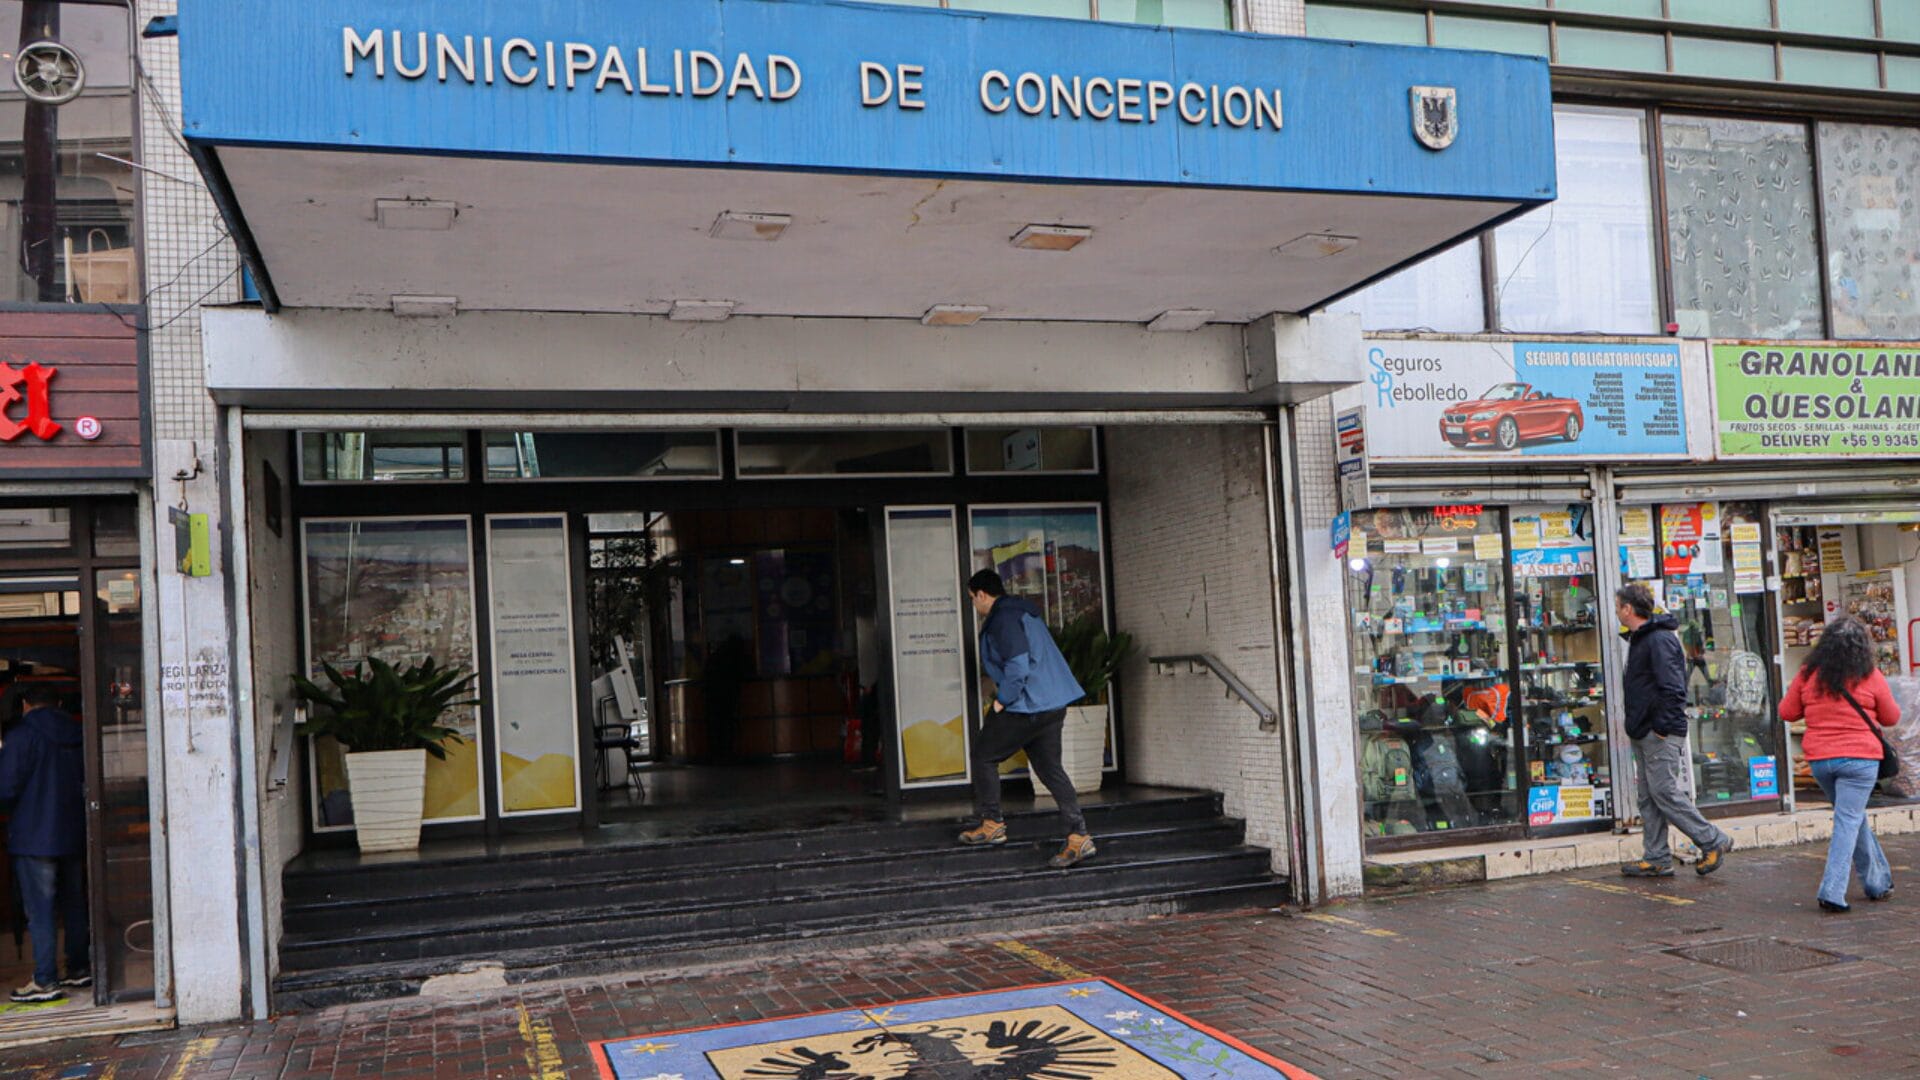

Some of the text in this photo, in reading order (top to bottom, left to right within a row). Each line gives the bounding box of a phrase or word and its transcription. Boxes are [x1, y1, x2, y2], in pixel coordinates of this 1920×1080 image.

[343, 27, 1283, 130] MUNICIPALIDAD DE CONCEPCION
[1369, 348, 1442, 383] Seguros
[1525, 351, 1569, 366] SEGURO
[1377, 371, 1468, 408] Rebolledo
[1850, 378, 1863, 394] &
[1744, 394, 1920, 420] QUESOLAN
[1730, 423, 1765, 432] FRUTOS
[1767, 423, 1796, 432] SECOS
[1804, 423, 1845, 432] SEMILLAS
[1761, 434, 1918, 447] DELIVERY +56 9 9345
[1434, 503, 1483, 517] LLAVES
